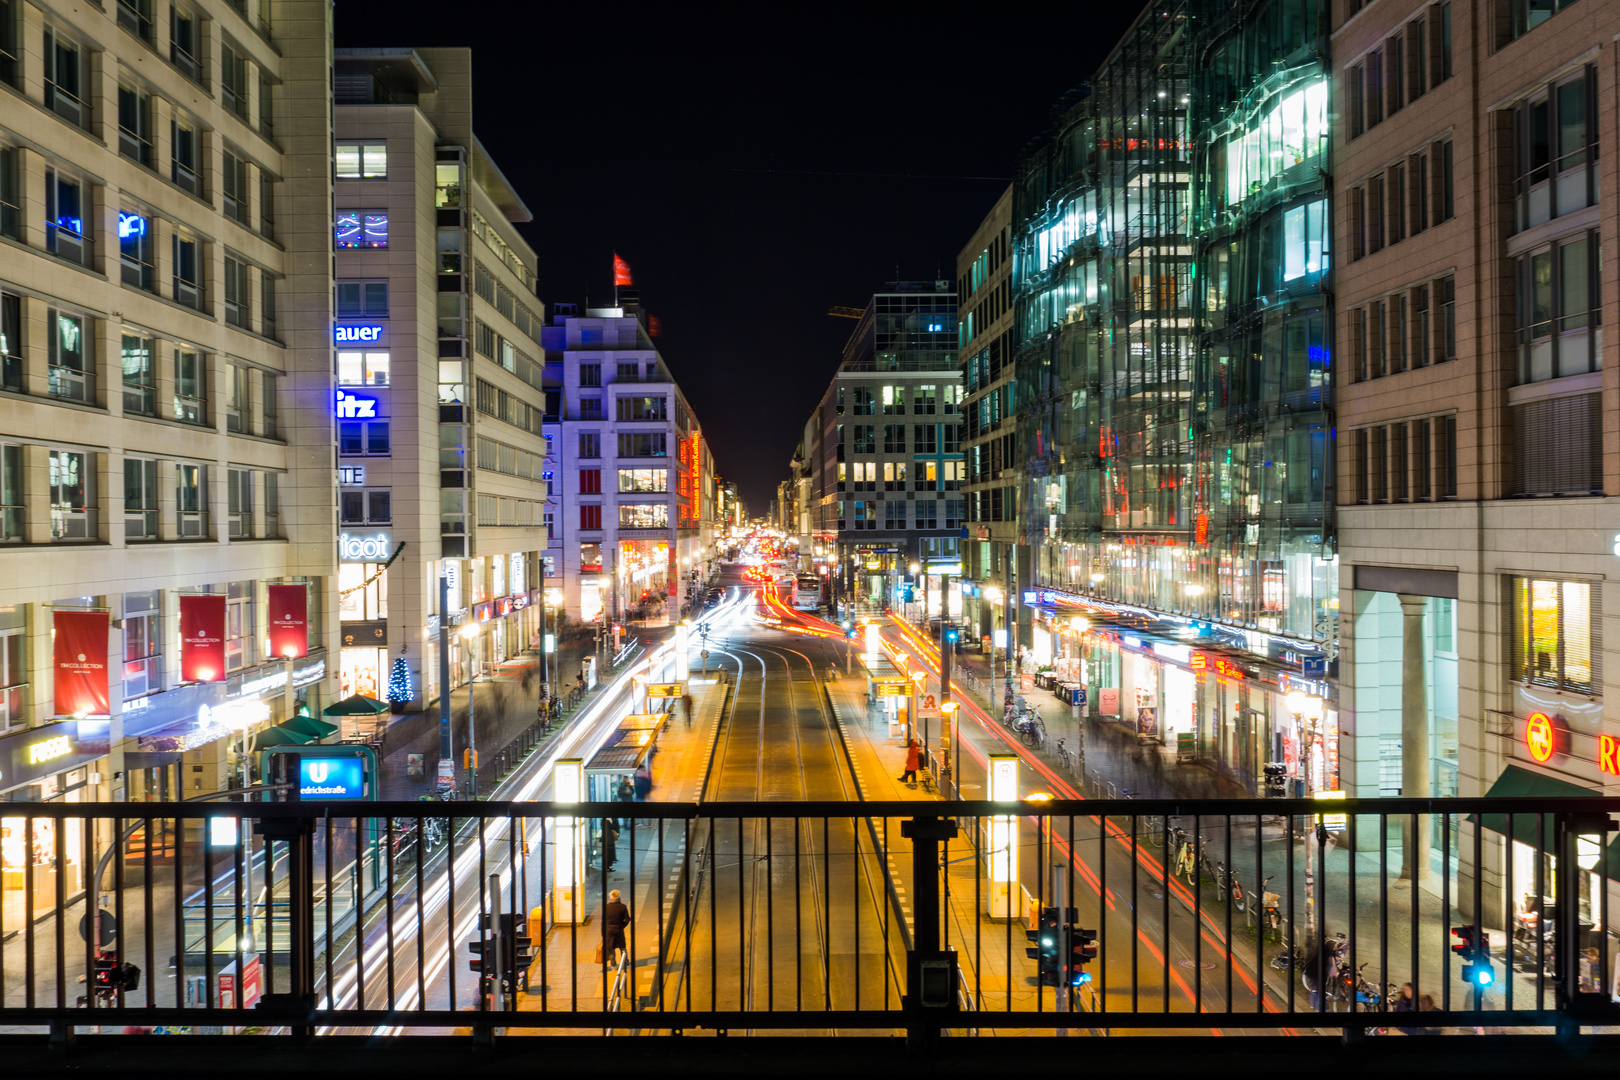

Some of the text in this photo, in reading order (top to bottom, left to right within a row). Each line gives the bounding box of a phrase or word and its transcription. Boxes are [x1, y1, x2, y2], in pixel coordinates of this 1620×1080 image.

[336, 326, 382, 341] auer
[337, 390, 375, 418] itz
[340, 467, 364, 484] TE
[309, 762, 328, 783] U
